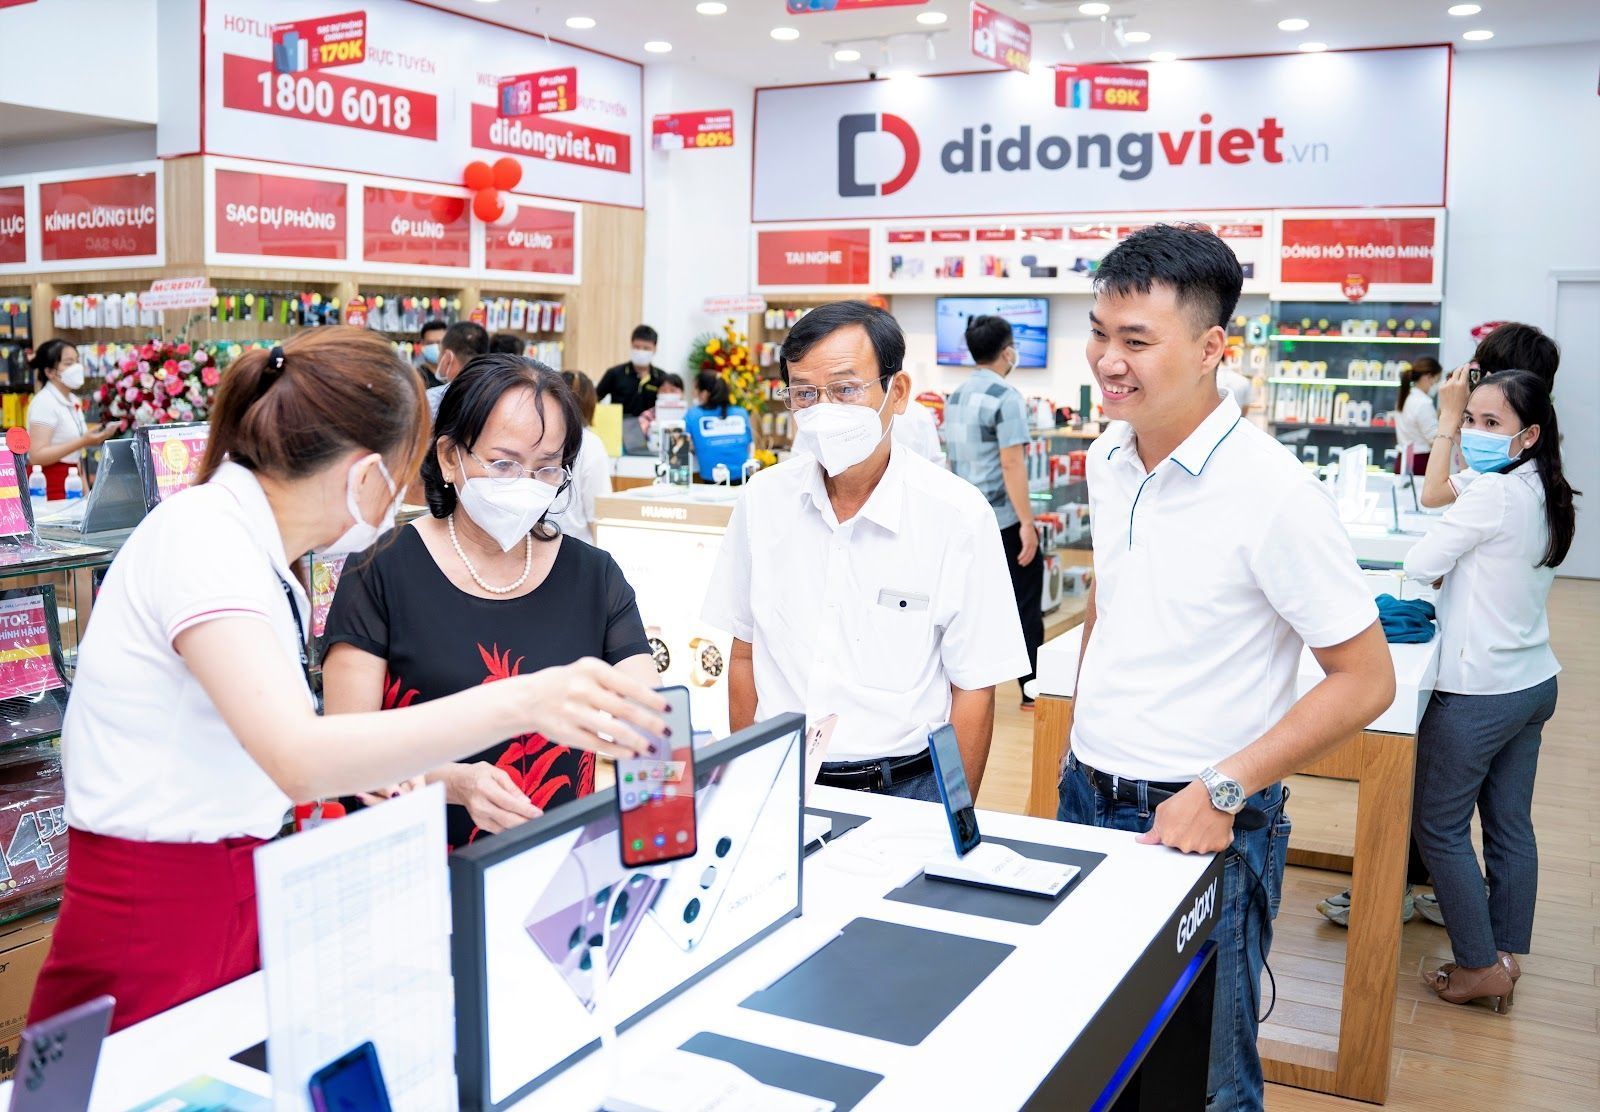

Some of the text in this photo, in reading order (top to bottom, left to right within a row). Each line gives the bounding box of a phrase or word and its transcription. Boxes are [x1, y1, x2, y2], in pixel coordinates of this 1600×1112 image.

[319, 38, 364, 64] 170K
[256, 71, 412, 131] 1800 6018
[1104, 88, 1141, 106] 69K
[489, 117, 617, 164] didongviet.vn
[695, 130, 733, 147] 60%
[940, 113, 1330, 181] didongviet.vn
[45, 209, 76, 232] KÍNH
[127, 203, 155, 229] LỰC
[226, 202, 336, 231] SẠC DỰ PHÒNG
[784, 250, 843, 265] TAI NGHE
[1346, 242, 1396, 259] THÔNG
[640, 504, 688, 521] HUAWEI
[0, 629, 20, 641] HÍNH
[1176, 876, 1218, 954] Galaxy
